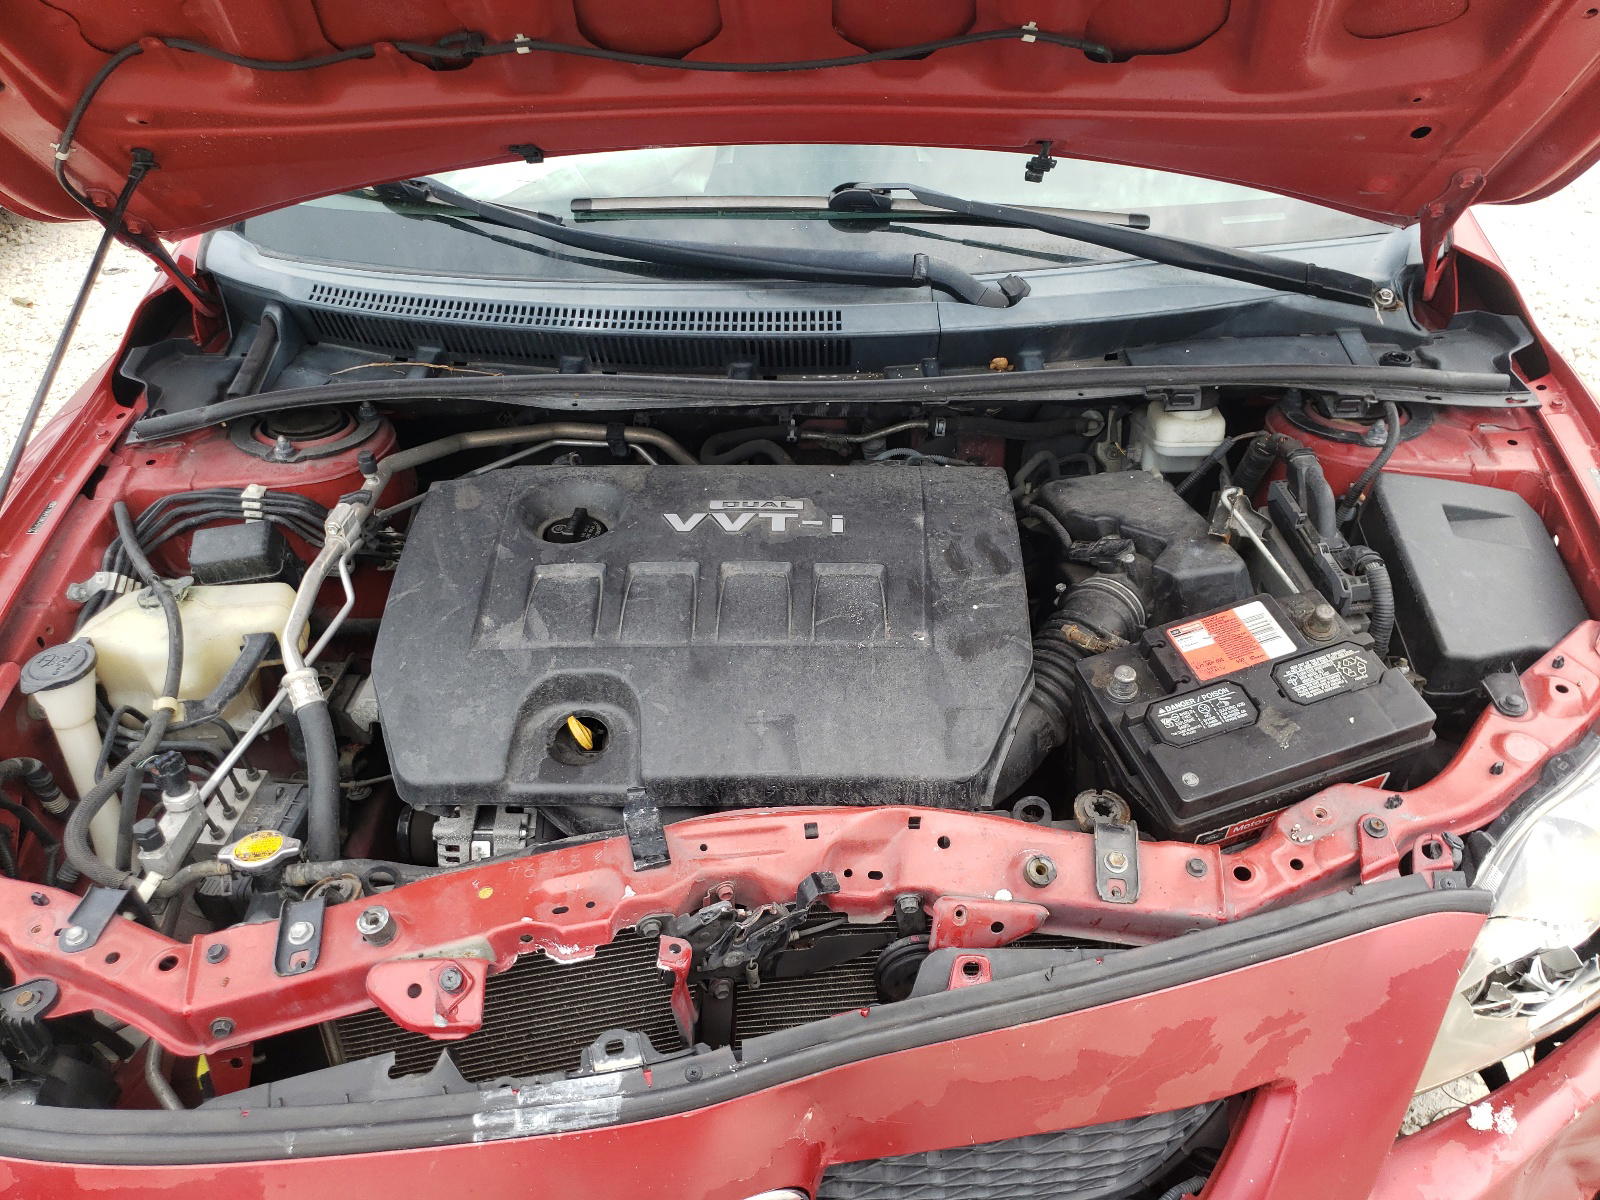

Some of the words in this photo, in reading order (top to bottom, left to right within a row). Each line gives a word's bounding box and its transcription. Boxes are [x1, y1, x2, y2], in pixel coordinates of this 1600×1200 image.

[662, 512, 845, 534] VVT-i
[1165, 698, 1196, 712] DANGER
[1201, 687, 1230, 701] POISON
